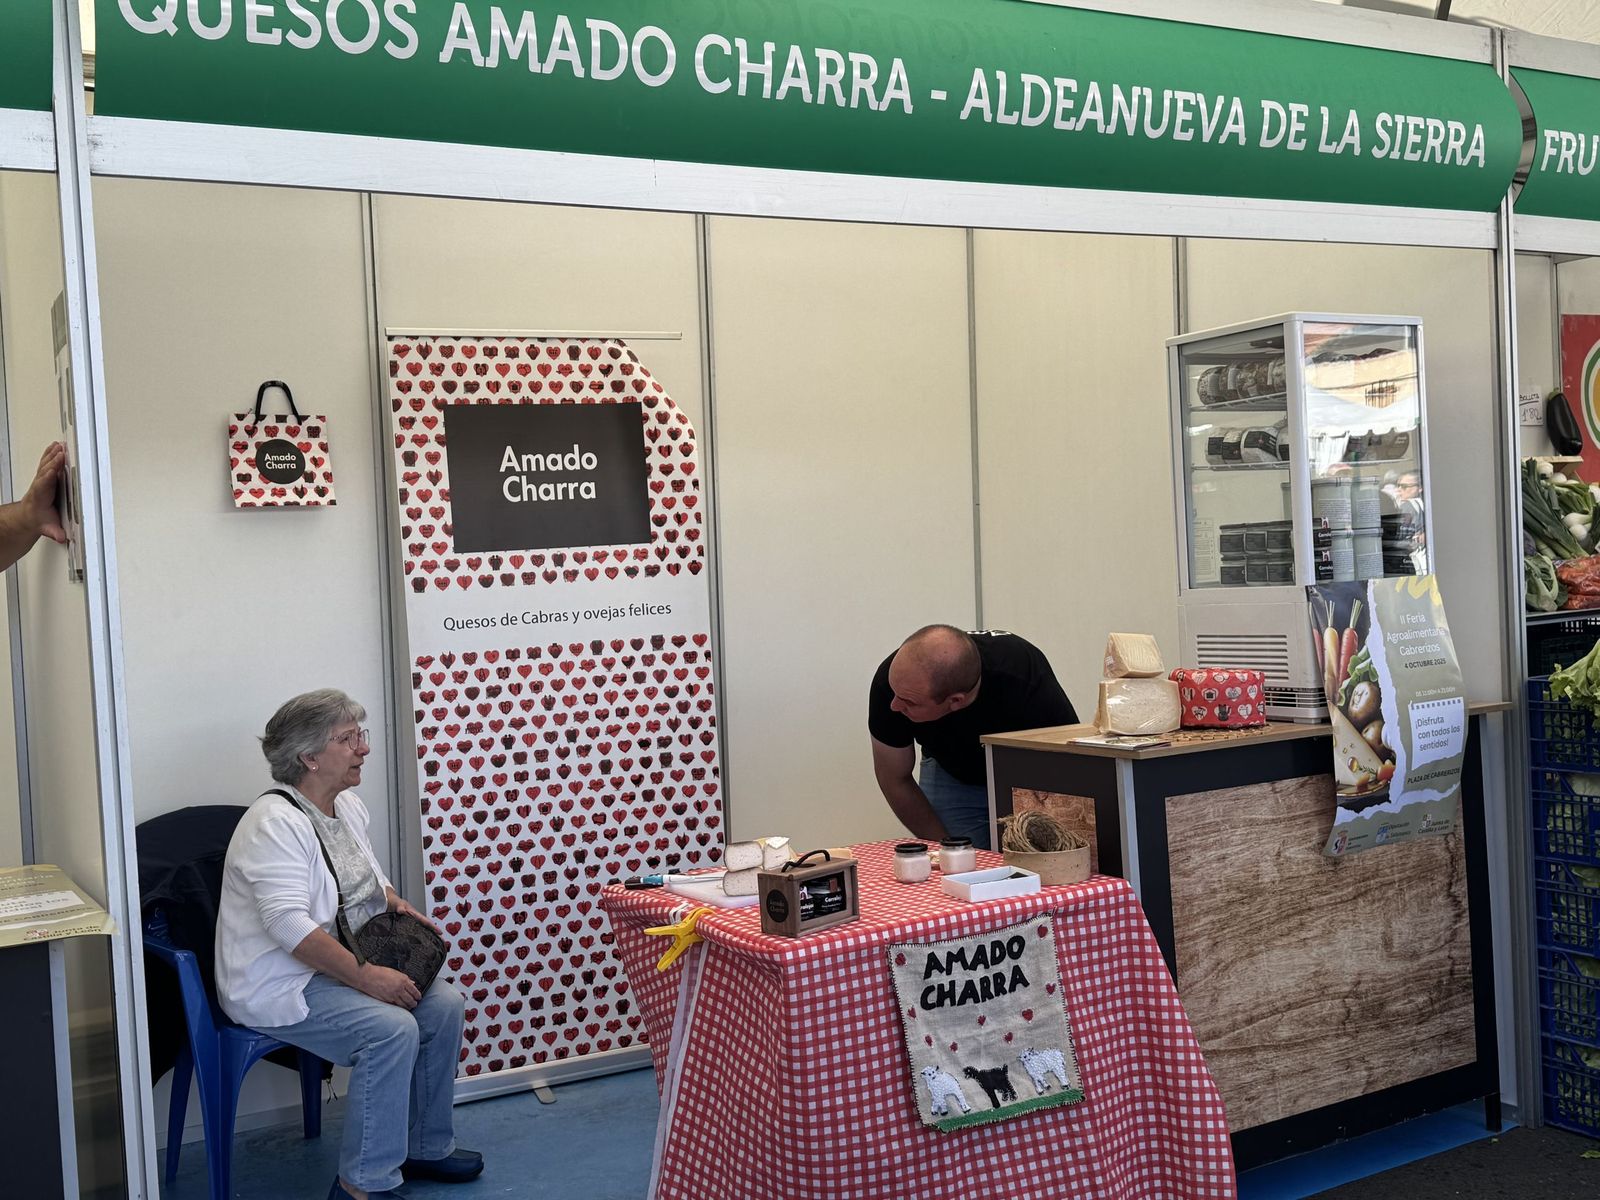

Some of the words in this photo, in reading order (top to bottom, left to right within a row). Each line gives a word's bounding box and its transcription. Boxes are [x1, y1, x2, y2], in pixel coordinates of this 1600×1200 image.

[117, 0, 420, 59] QUESOS
[438, 1, 677, 87] AMADO
[694, 33, 914, 115] CHARRA
[959, 67, 1247, 147] ALDEANUEVA
[1259, 99, 1308, 151] DE
[1317, 106, 1361, 156] LA
[1371, 112, 1486, 168] SIERRA
[1540, 129, 1600, 176] FRU
[264, 452, 297, 461] Amado
[499, 443, 598, 473] Amado
[265, 461, 297, 469] Charra
[502, 474, 597, 503] Charra
[443, 615, 497, 632] Quesos
[500, 612, 518, 626] de
[521, 610, 569, 625] Cabras
[572, 610, 580, 624] y
[583, 605, 626, 621] ovejas
[628, 603, 672, 617] felices
[1406, 612, 1426, 624] Feria
[1399, 643, 1441, 656] Cabrerizos
[1408, 659, 1434, 669] OCTUBRE
[1417, 730, 1431, 740] con
[1431, 726, 1450, 737] todos
[1450, 724, 1461, 733] los
[1419, 739, 1449, 752] sentidos!
[1407, 775, 1424, 784] PLAZA
[1423, 772, 1431, 780] DE
[923, 935, 1026, 980] AMADO
[920, 964, 1030, 1011] CHARRA
